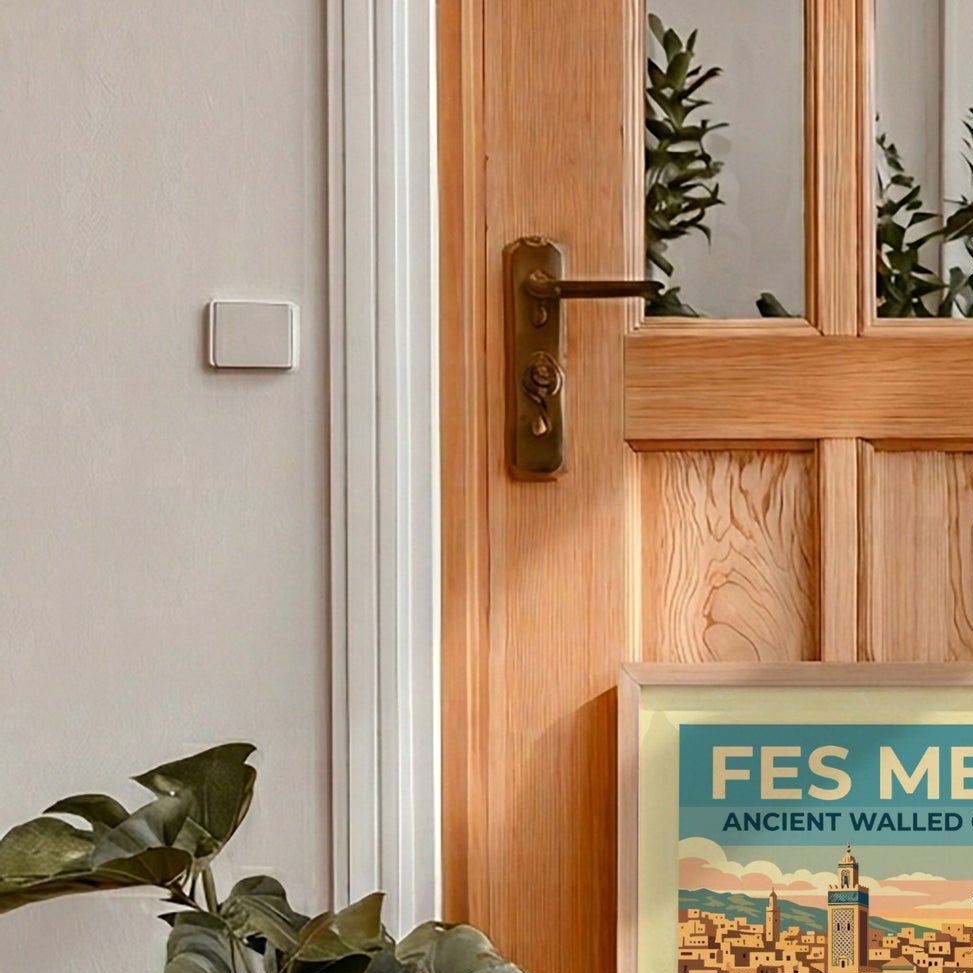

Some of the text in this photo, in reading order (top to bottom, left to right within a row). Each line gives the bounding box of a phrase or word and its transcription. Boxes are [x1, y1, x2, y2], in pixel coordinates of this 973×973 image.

[712, 745, 852, 801] FES
[722, 812, 842, 832] ANCIENT
[850, 812, 963, 832] WALLED
